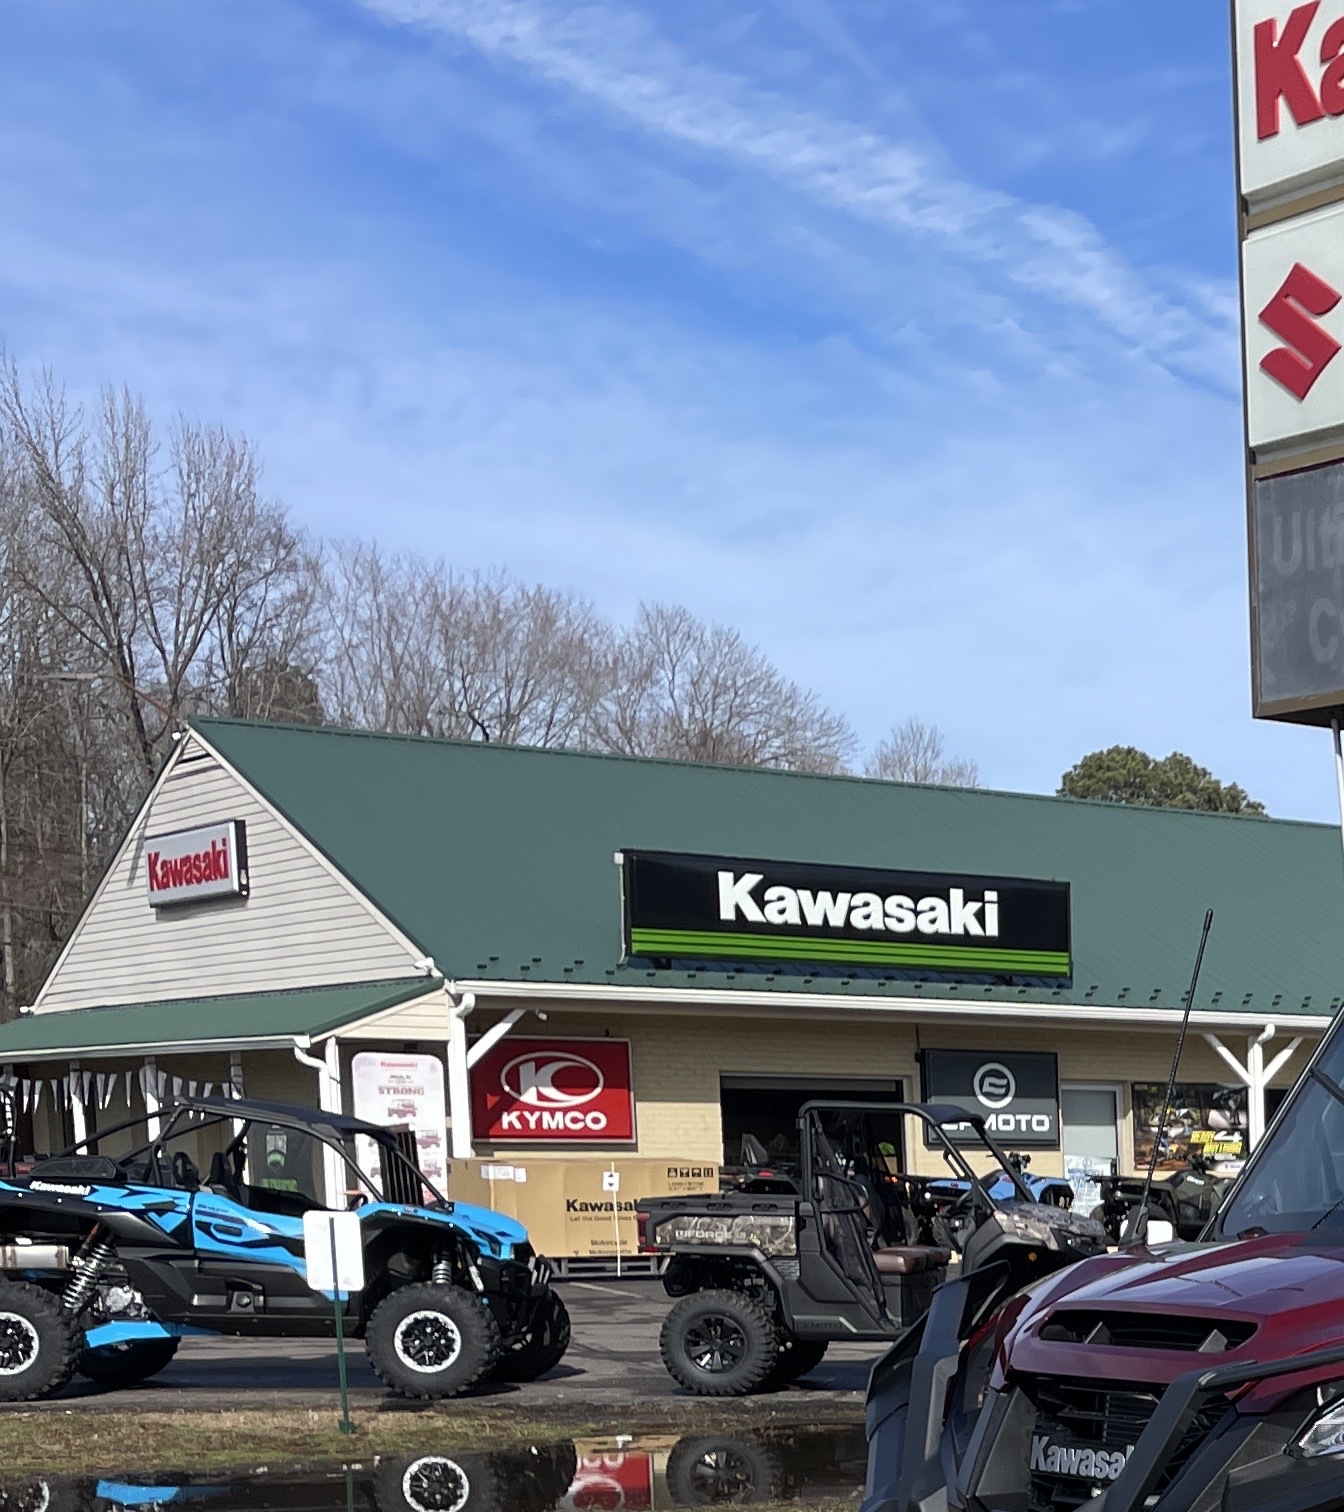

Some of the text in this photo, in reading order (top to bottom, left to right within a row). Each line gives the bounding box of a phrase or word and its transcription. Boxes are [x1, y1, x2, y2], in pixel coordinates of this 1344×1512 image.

[148, 837, 229, 892] Kawasaki
[718, 871, 999, 937] Kawasaki
[501, 1111, 607, 1130] KYMCO
[941, 1113, 1050, 1132] MOTO
[29, 1180, 91, 1196] Kawasaki
[566, 1198, 639, 1212] Kawasak
[1030, 1435, 1135, 1480] Kawasa
